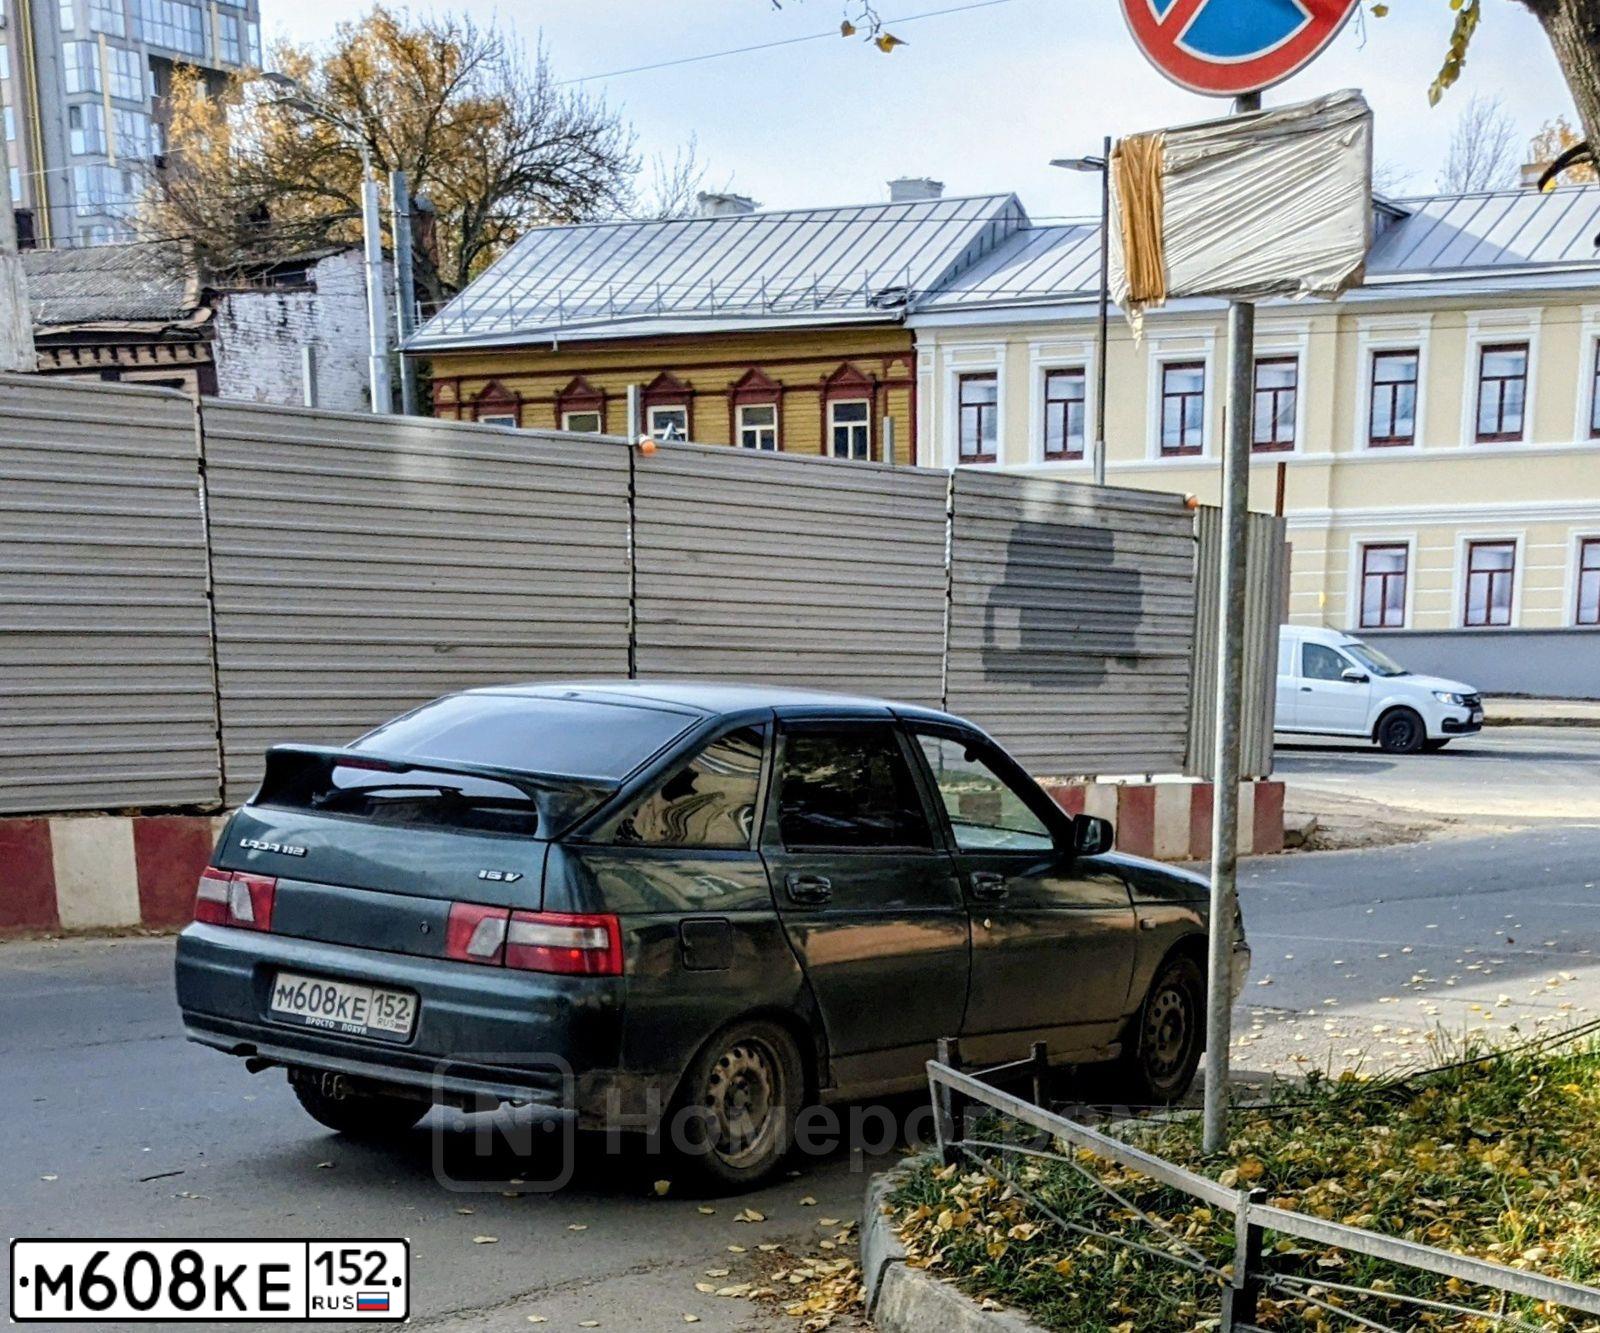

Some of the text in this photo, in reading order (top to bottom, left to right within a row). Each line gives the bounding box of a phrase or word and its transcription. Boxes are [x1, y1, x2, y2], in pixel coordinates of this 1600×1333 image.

[239, 838, 305, 857] LADA 112
[278, 981, 409, 1021] М608КЕ 152
[305, 1016, 335, 1029] ПРОСТО
[377, 1017, 395, 1028] RUS
